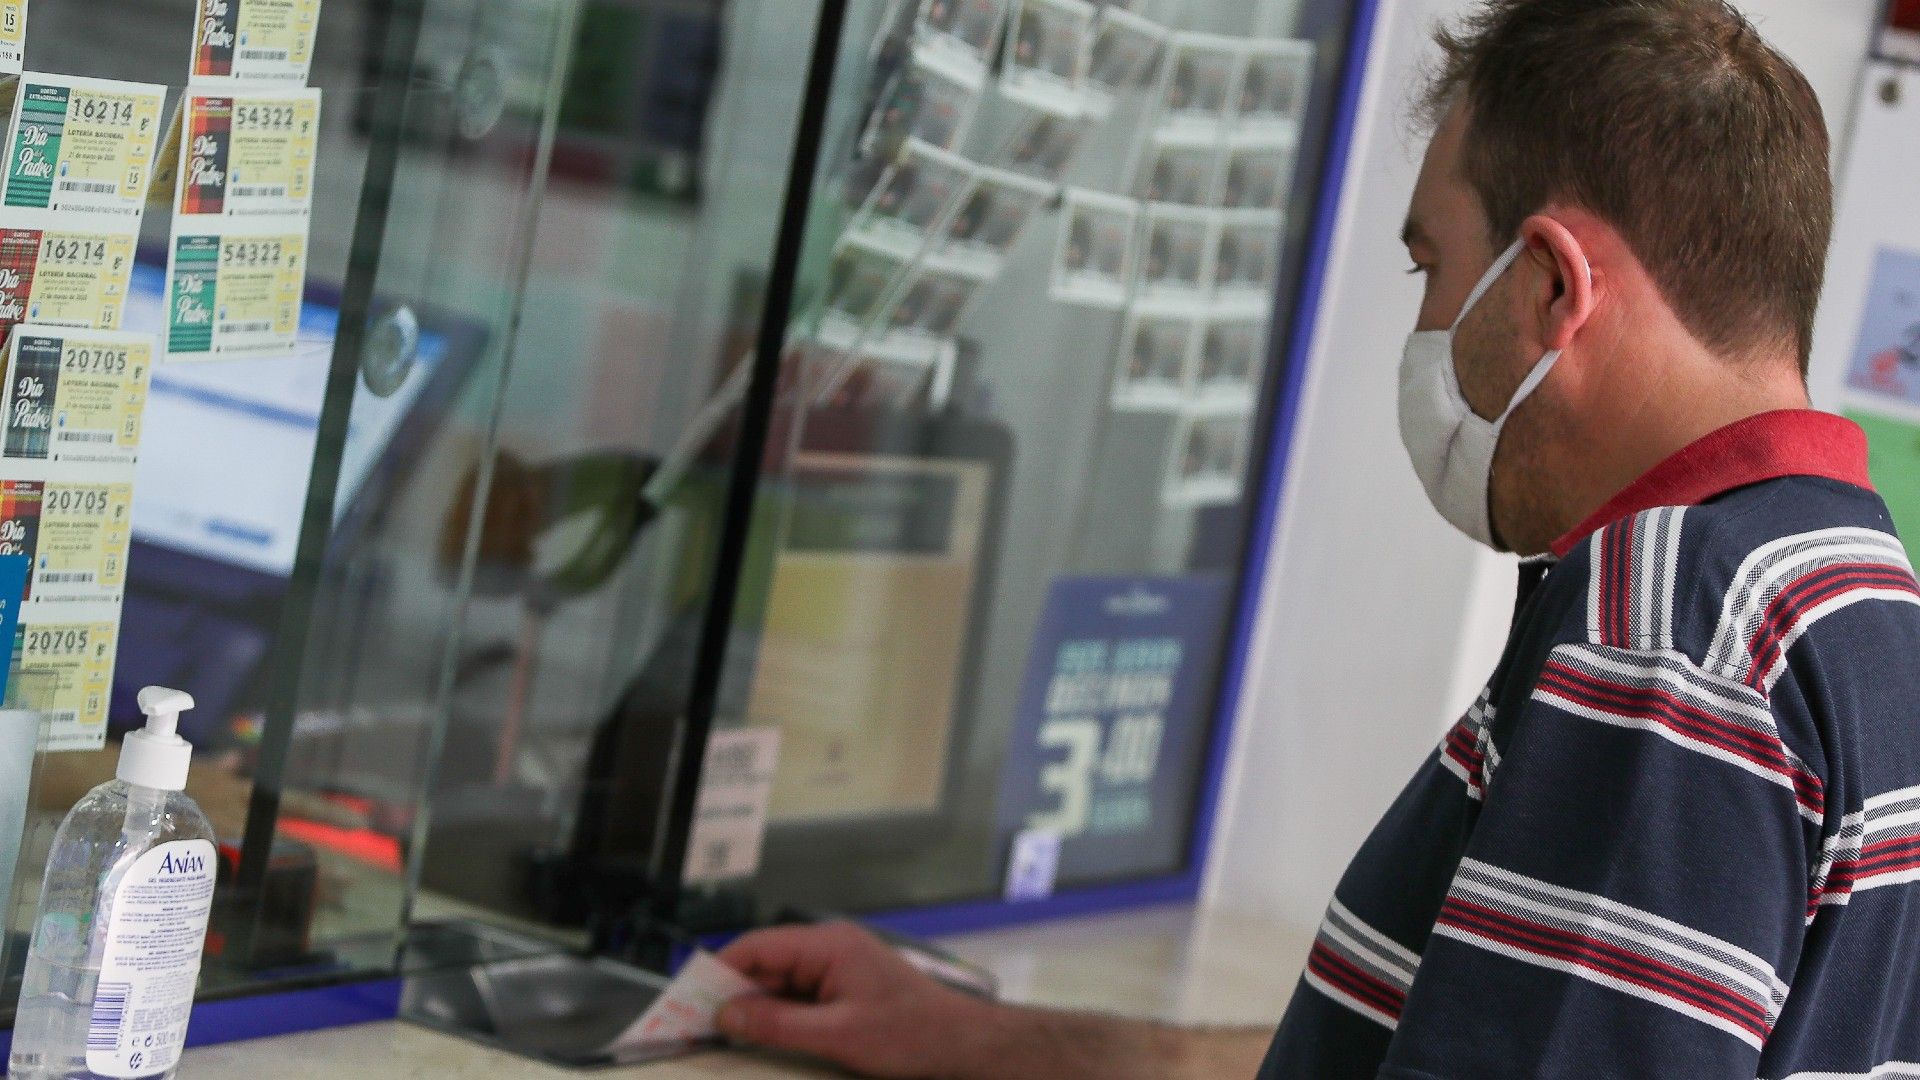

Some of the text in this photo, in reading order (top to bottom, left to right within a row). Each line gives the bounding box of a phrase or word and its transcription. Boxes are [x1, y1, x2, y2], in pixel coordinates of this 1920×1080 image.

[5, 13, 15, 26] 15
[74, 98, 133, 121] 16214
[238, 106, 294, 125] 54322
[22, 125, 48, 146] Día
[193, 135, 217, 156] Día
[15, 148, 53, 178] Padre
[190, 157, 225, 187] Padre
[128, 172, 139, 184] 15
[46, 239, 105, 261] 16214
[224, 243, 281, 262] 54322
[66, 349, 128, 371] 20705
[17, 377, 44, 398] Día
[13, 398, 50, 429] Padre
[47, 491, 108, 510] 20705
[0, 520, 26, 541] Día
[28, 630, 89, 650] 20705
